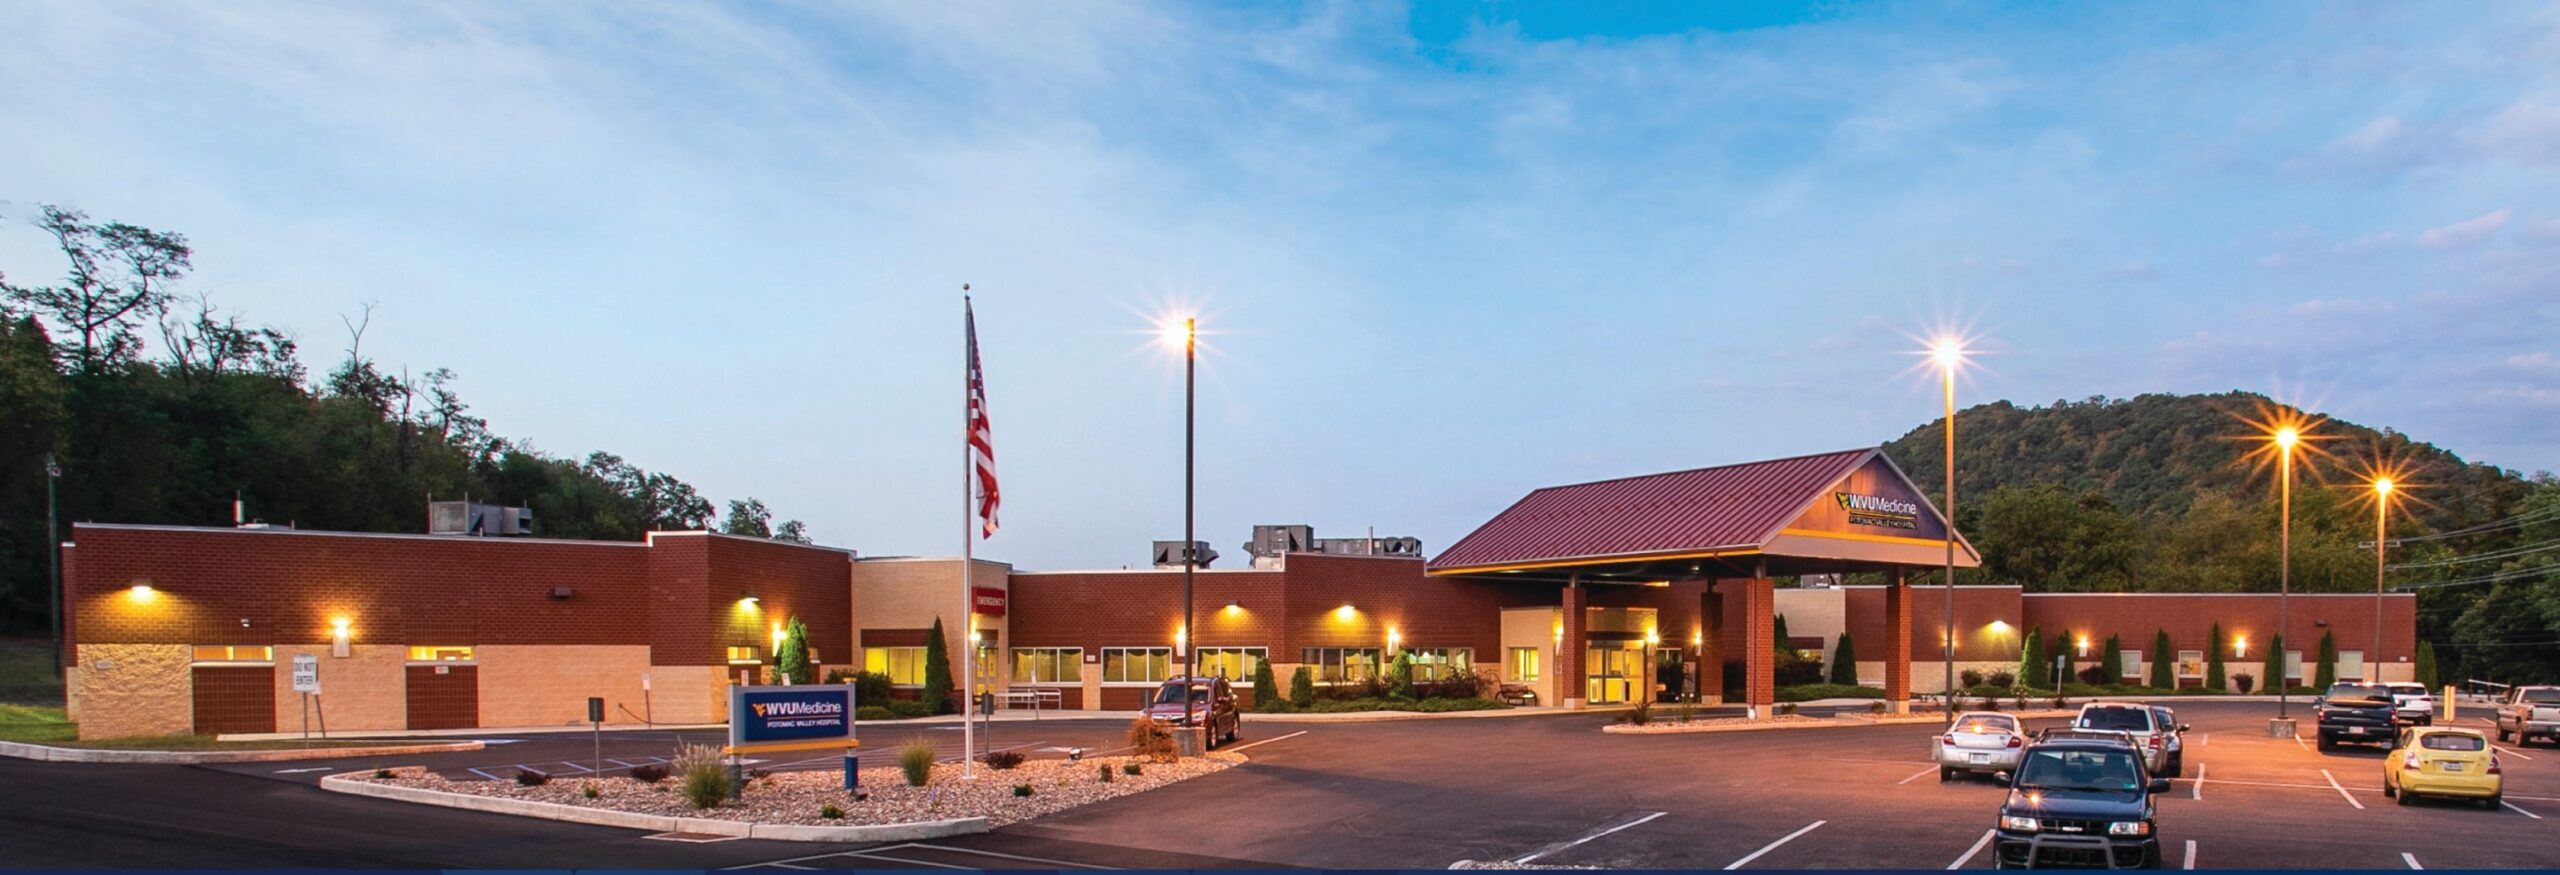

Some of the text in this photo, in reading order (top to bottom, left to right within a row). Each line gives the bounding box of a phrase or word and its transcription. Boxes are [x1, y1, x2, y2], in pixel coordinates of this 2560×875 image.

[977, 596, 1004, 606] EMERGENCY
[294, 662, 316, 672] DO NOT
[296, 675, 313, 685] ENTER
[796, 719, 816, 727] VALLEY
